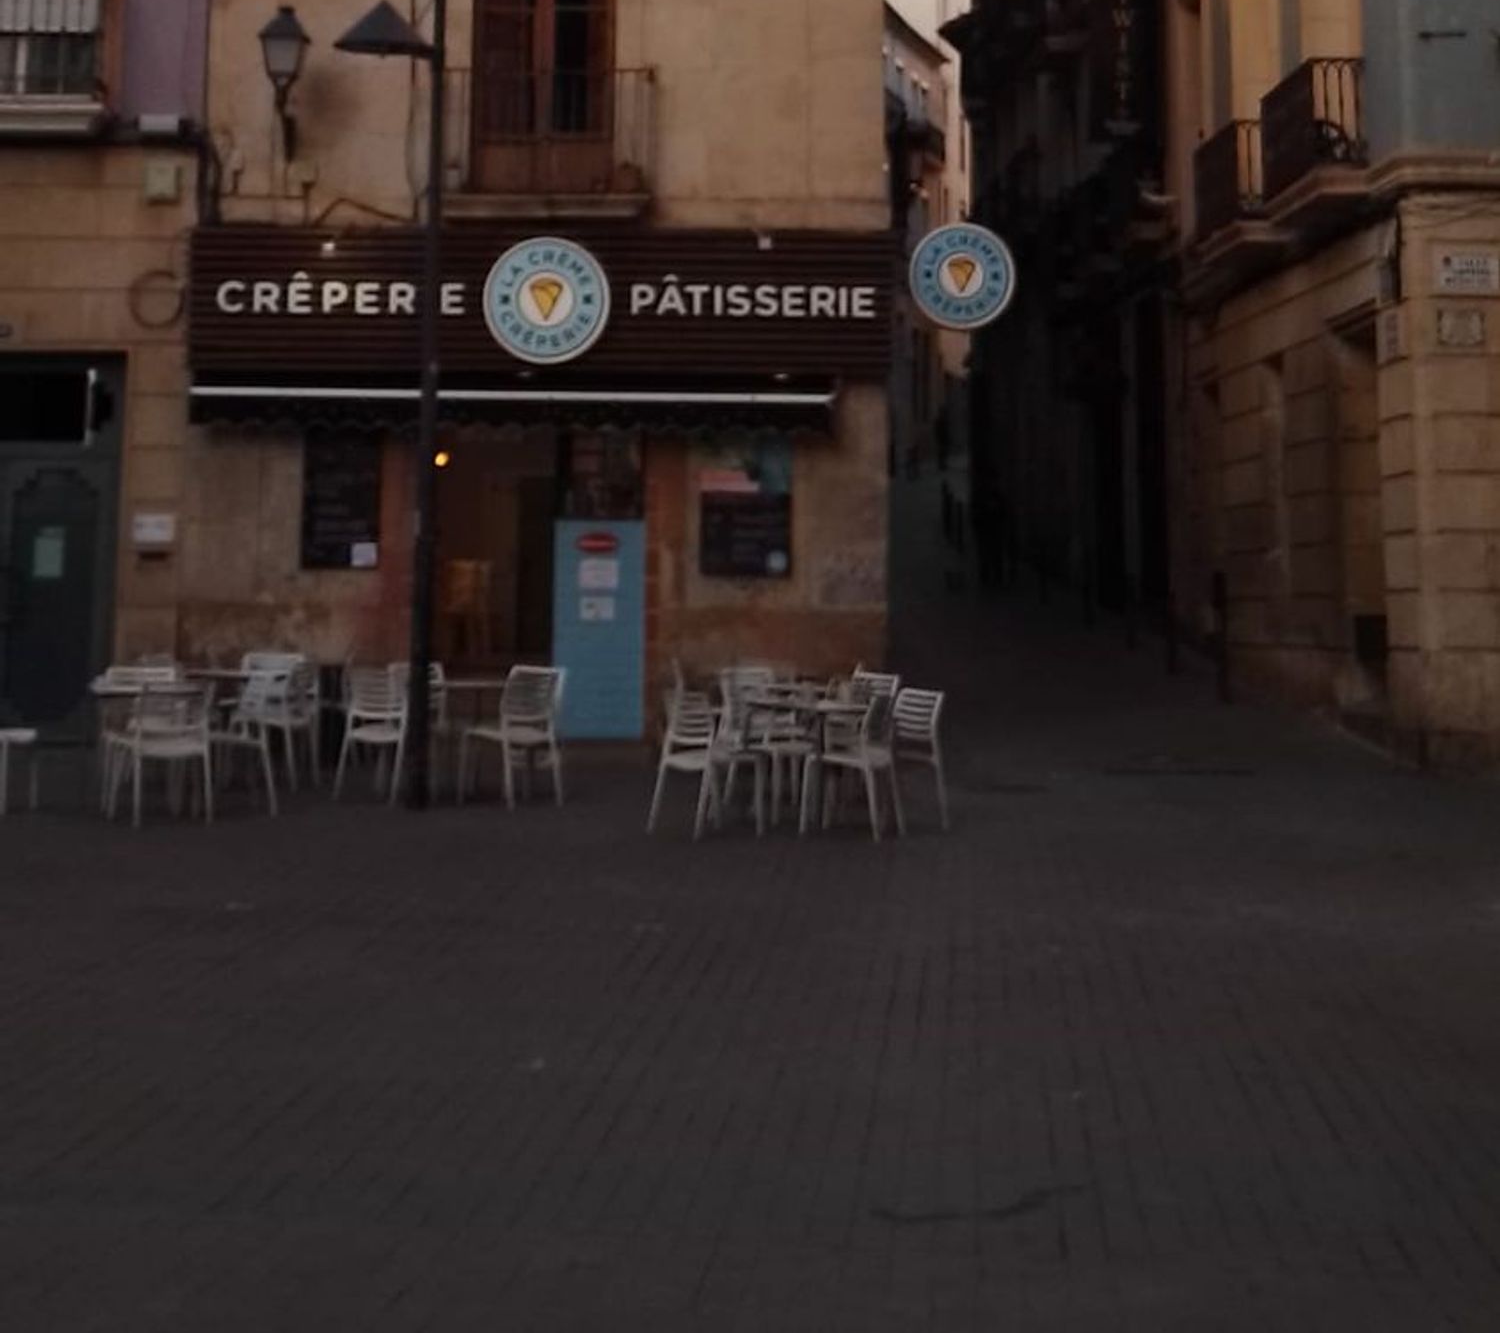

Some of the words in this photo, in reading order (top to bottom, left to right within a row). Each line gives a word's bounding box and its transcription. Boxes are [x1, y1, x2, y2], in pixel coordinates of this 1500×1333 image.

[216, 270, 467, 315] CRÊPERE
[629, 273, 877, 318] PÂTISSERIE
[501, 265, 524, 288] LA
